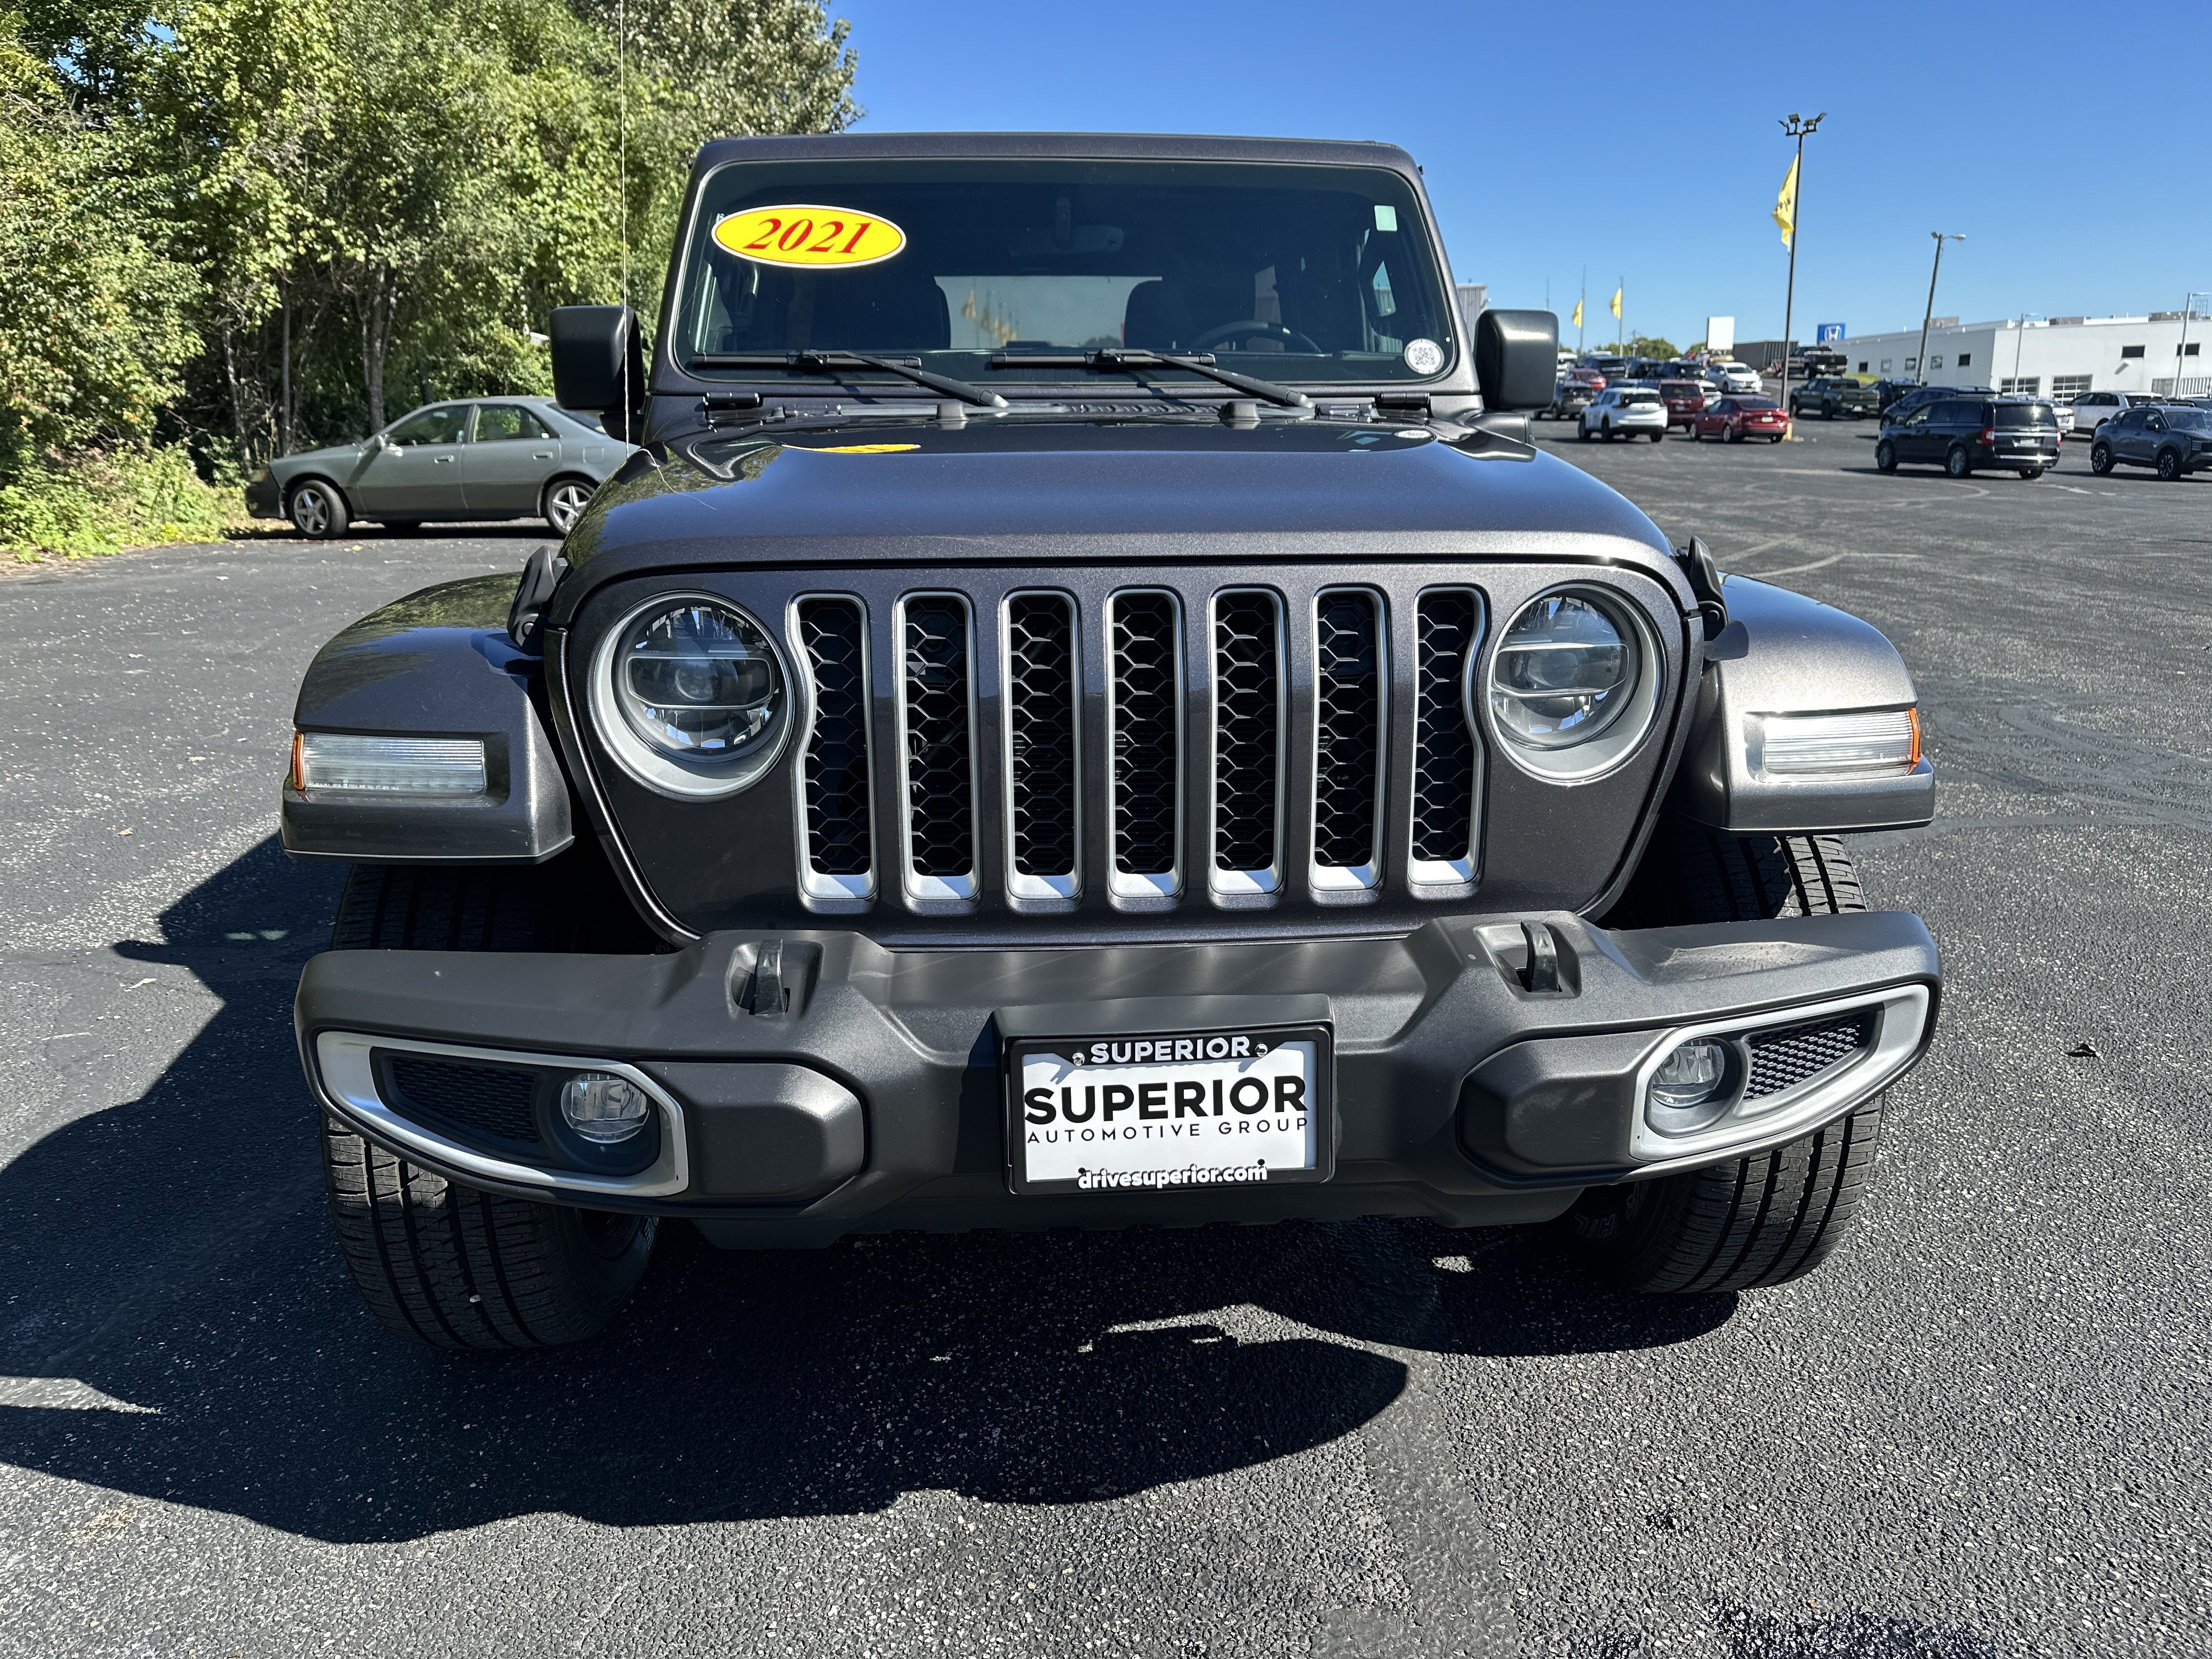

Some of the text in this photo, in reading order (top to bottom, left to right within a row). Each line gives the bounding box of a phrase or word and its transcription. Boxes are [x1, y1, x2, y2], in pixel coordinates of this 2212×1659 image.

[742, 218, 872, 254] 2021
[1091, 1036, 1251, 1064] SUPERIOR
[1024, 1075, 1308, 1125] SUPERIOR
[1027, 1117, 1307, 1144] AUTOMOTIVE GROUP
[1077, 1163, 1267, 1189] drivesuperior.com
